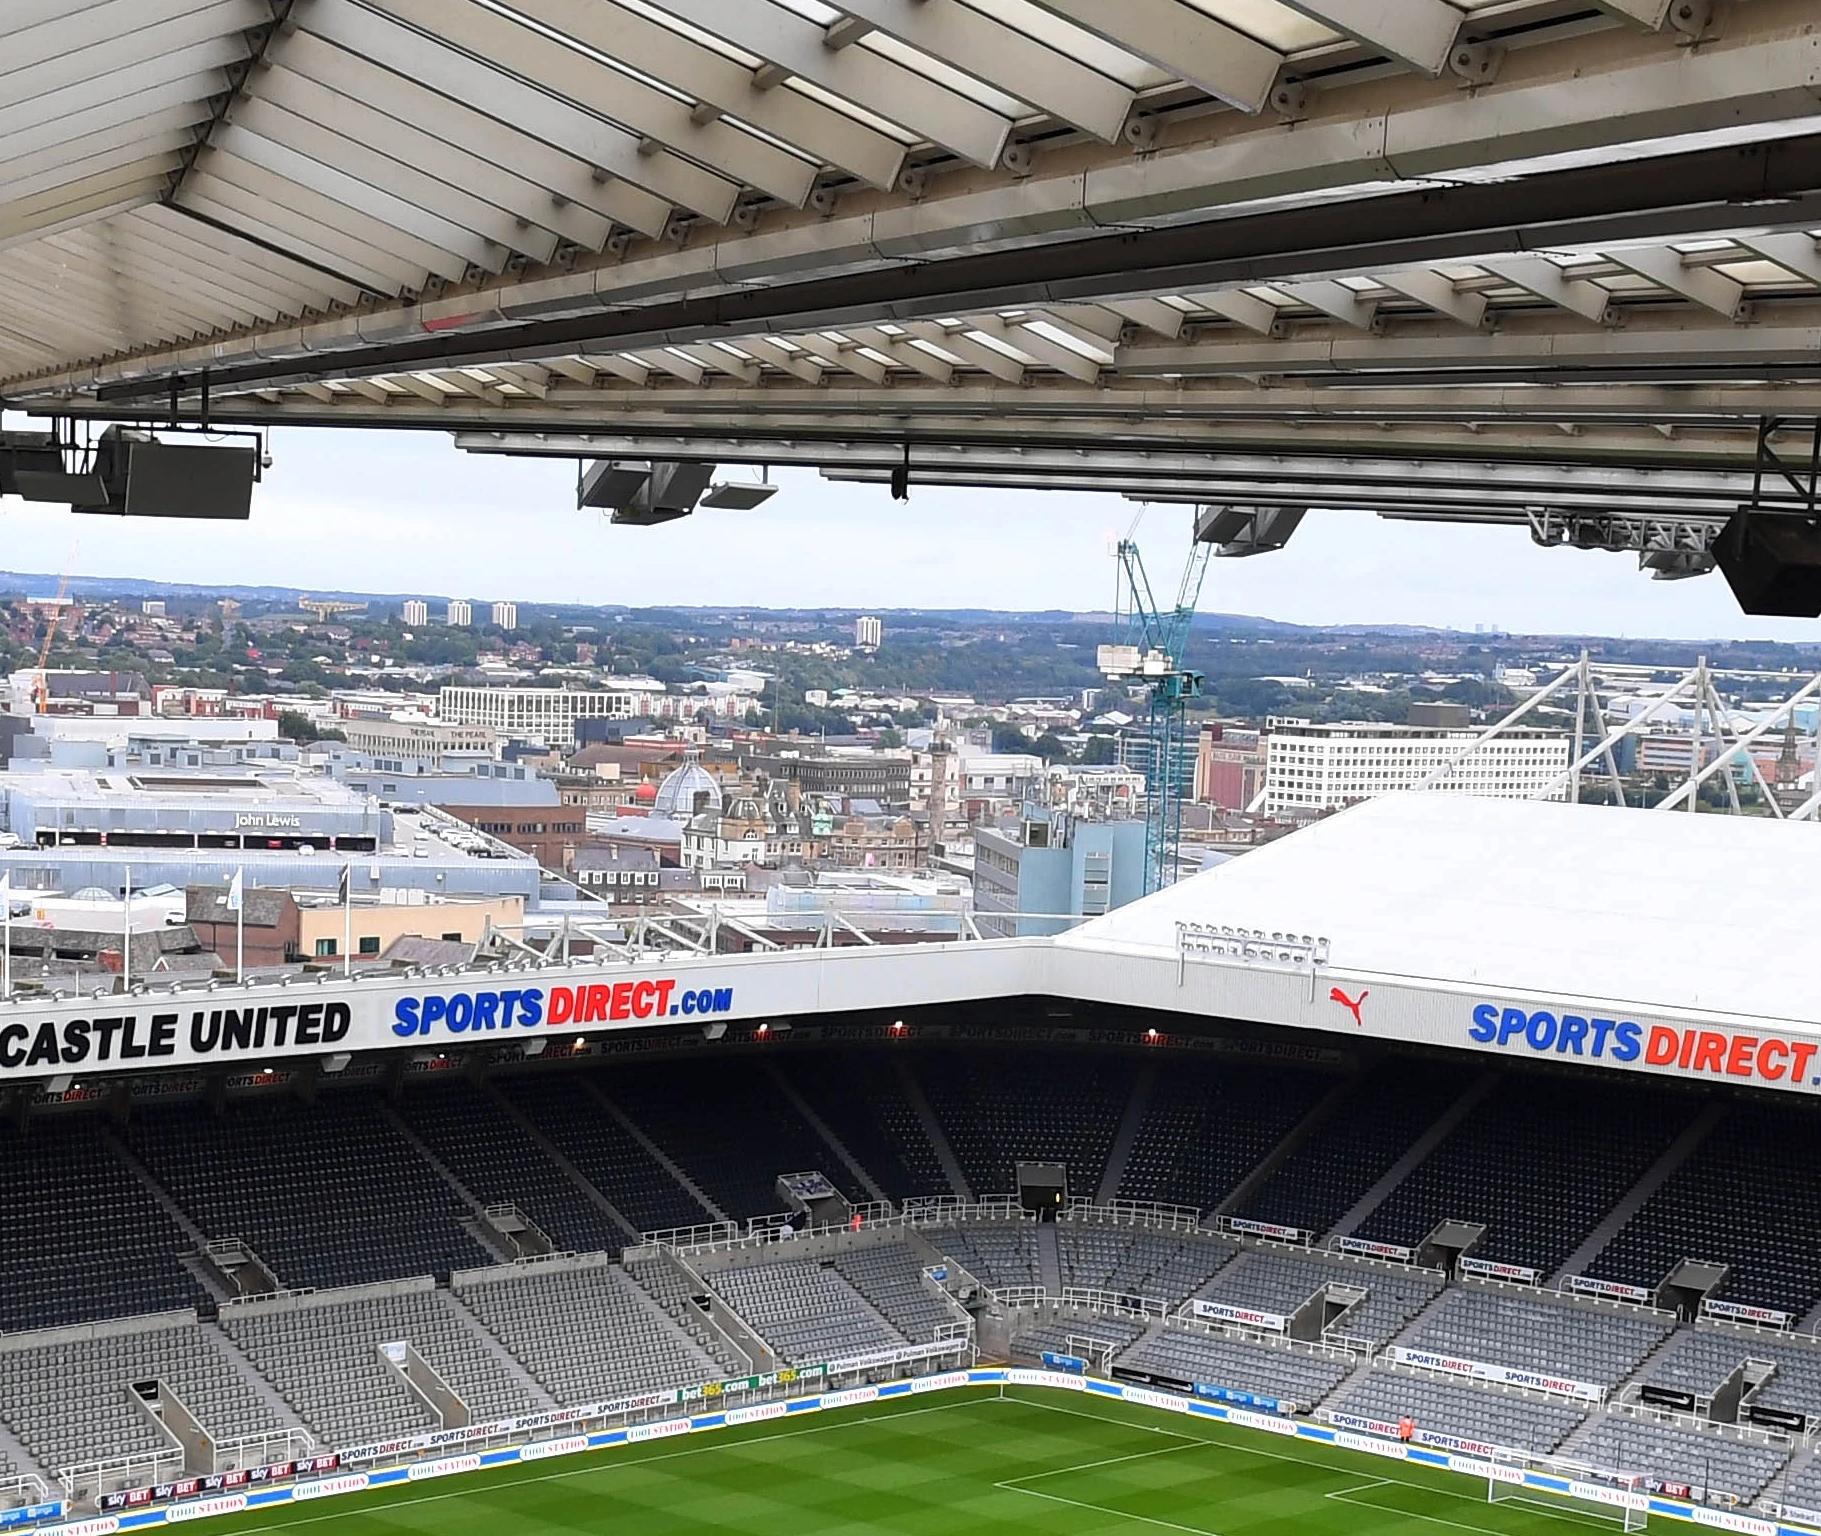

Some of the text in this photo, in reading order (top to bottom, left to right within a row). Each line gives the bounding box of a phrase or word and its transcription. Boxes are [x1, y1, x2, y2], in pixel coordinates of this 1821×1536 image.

[235, 812, 300, 828] John Lewis
[391, 979, 733, 1039] SPORTSDIRECT.COM
[189, 1001, 351, 1053] UNITED
[682, 1365, 823, 1400] bet365.com bet365.com
[914, 1372, 969, 1391] TOOLSTATION
[1012, 1372, 1083, 1388] TOOLSTATION
[823, 1388, 876, 1407] TOOLSTATION
[1126, 1388, 1186, 1411] TOOLSTATION
[728, 1403, 784, 1423] TOOLSTATION
[1231, 1410, 1295, 1432] TOOLSTATION
[630, 1420, 690, 1439] TOOLSTATION
[524, 1437, 586, 1458] TOOLSTATION
[1338, 1434, 1405, 1456] TOOLSTATION
[251, 1463, 290, 1481] sky BET
[296, 1454, 335, 1473] sky BET
[413, 1456, 478, 1476] TOOLSTATION
[155, 1480, 196, 1498] sky BET
[205, 1471, 245, 1489] sky BET
[296, 1476, 367, 1497] TOOLSTATION
[1665, 1482, 1686, 1496] BET
[108, 1488, 149, 1507] sky BET
[1573, 1484, 1647, 1509] TOOLSTATON
[171, 1497, 244, 1521] TOOLSTATION
[1698, 1511, 1773, 1534] TOOLSTATION
